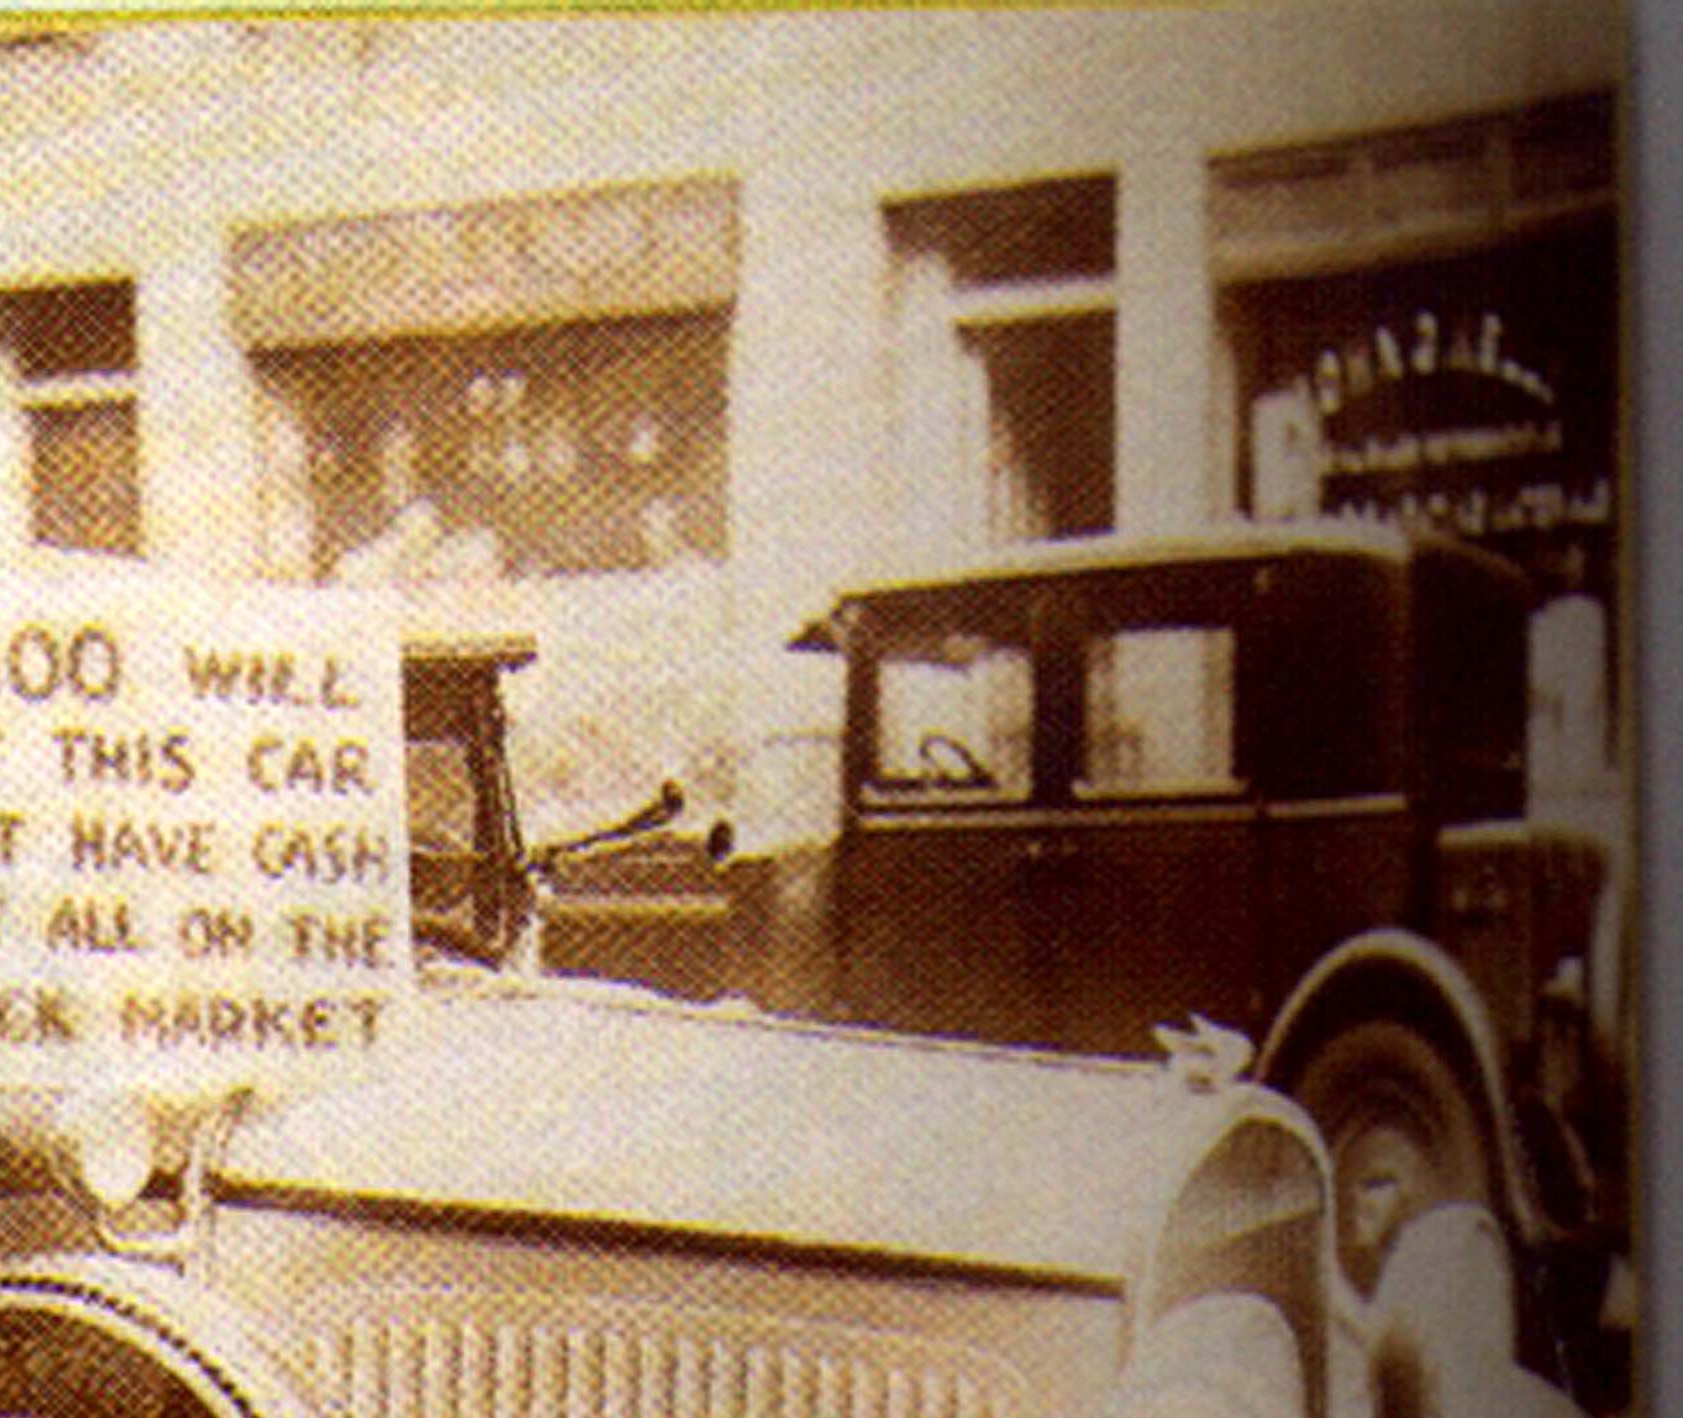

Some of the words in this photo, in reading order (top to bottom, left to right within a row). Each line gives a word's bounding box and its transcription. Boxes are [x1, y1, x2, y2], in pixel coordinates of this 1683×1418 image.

[186, 648, 359, 710] WILL
[53, 728, 196, 794] THIS
[245, 735, 374, 796] CAR
[69, 812, 215, 876] HAVE
[251, 823, 392, 886] CASH
[44, 896, 147, 954] ALL
[177, 906, 255, 960] ON
[282, 911, 395, 972] THE
[118, 992, 387, 1051] MARKET
